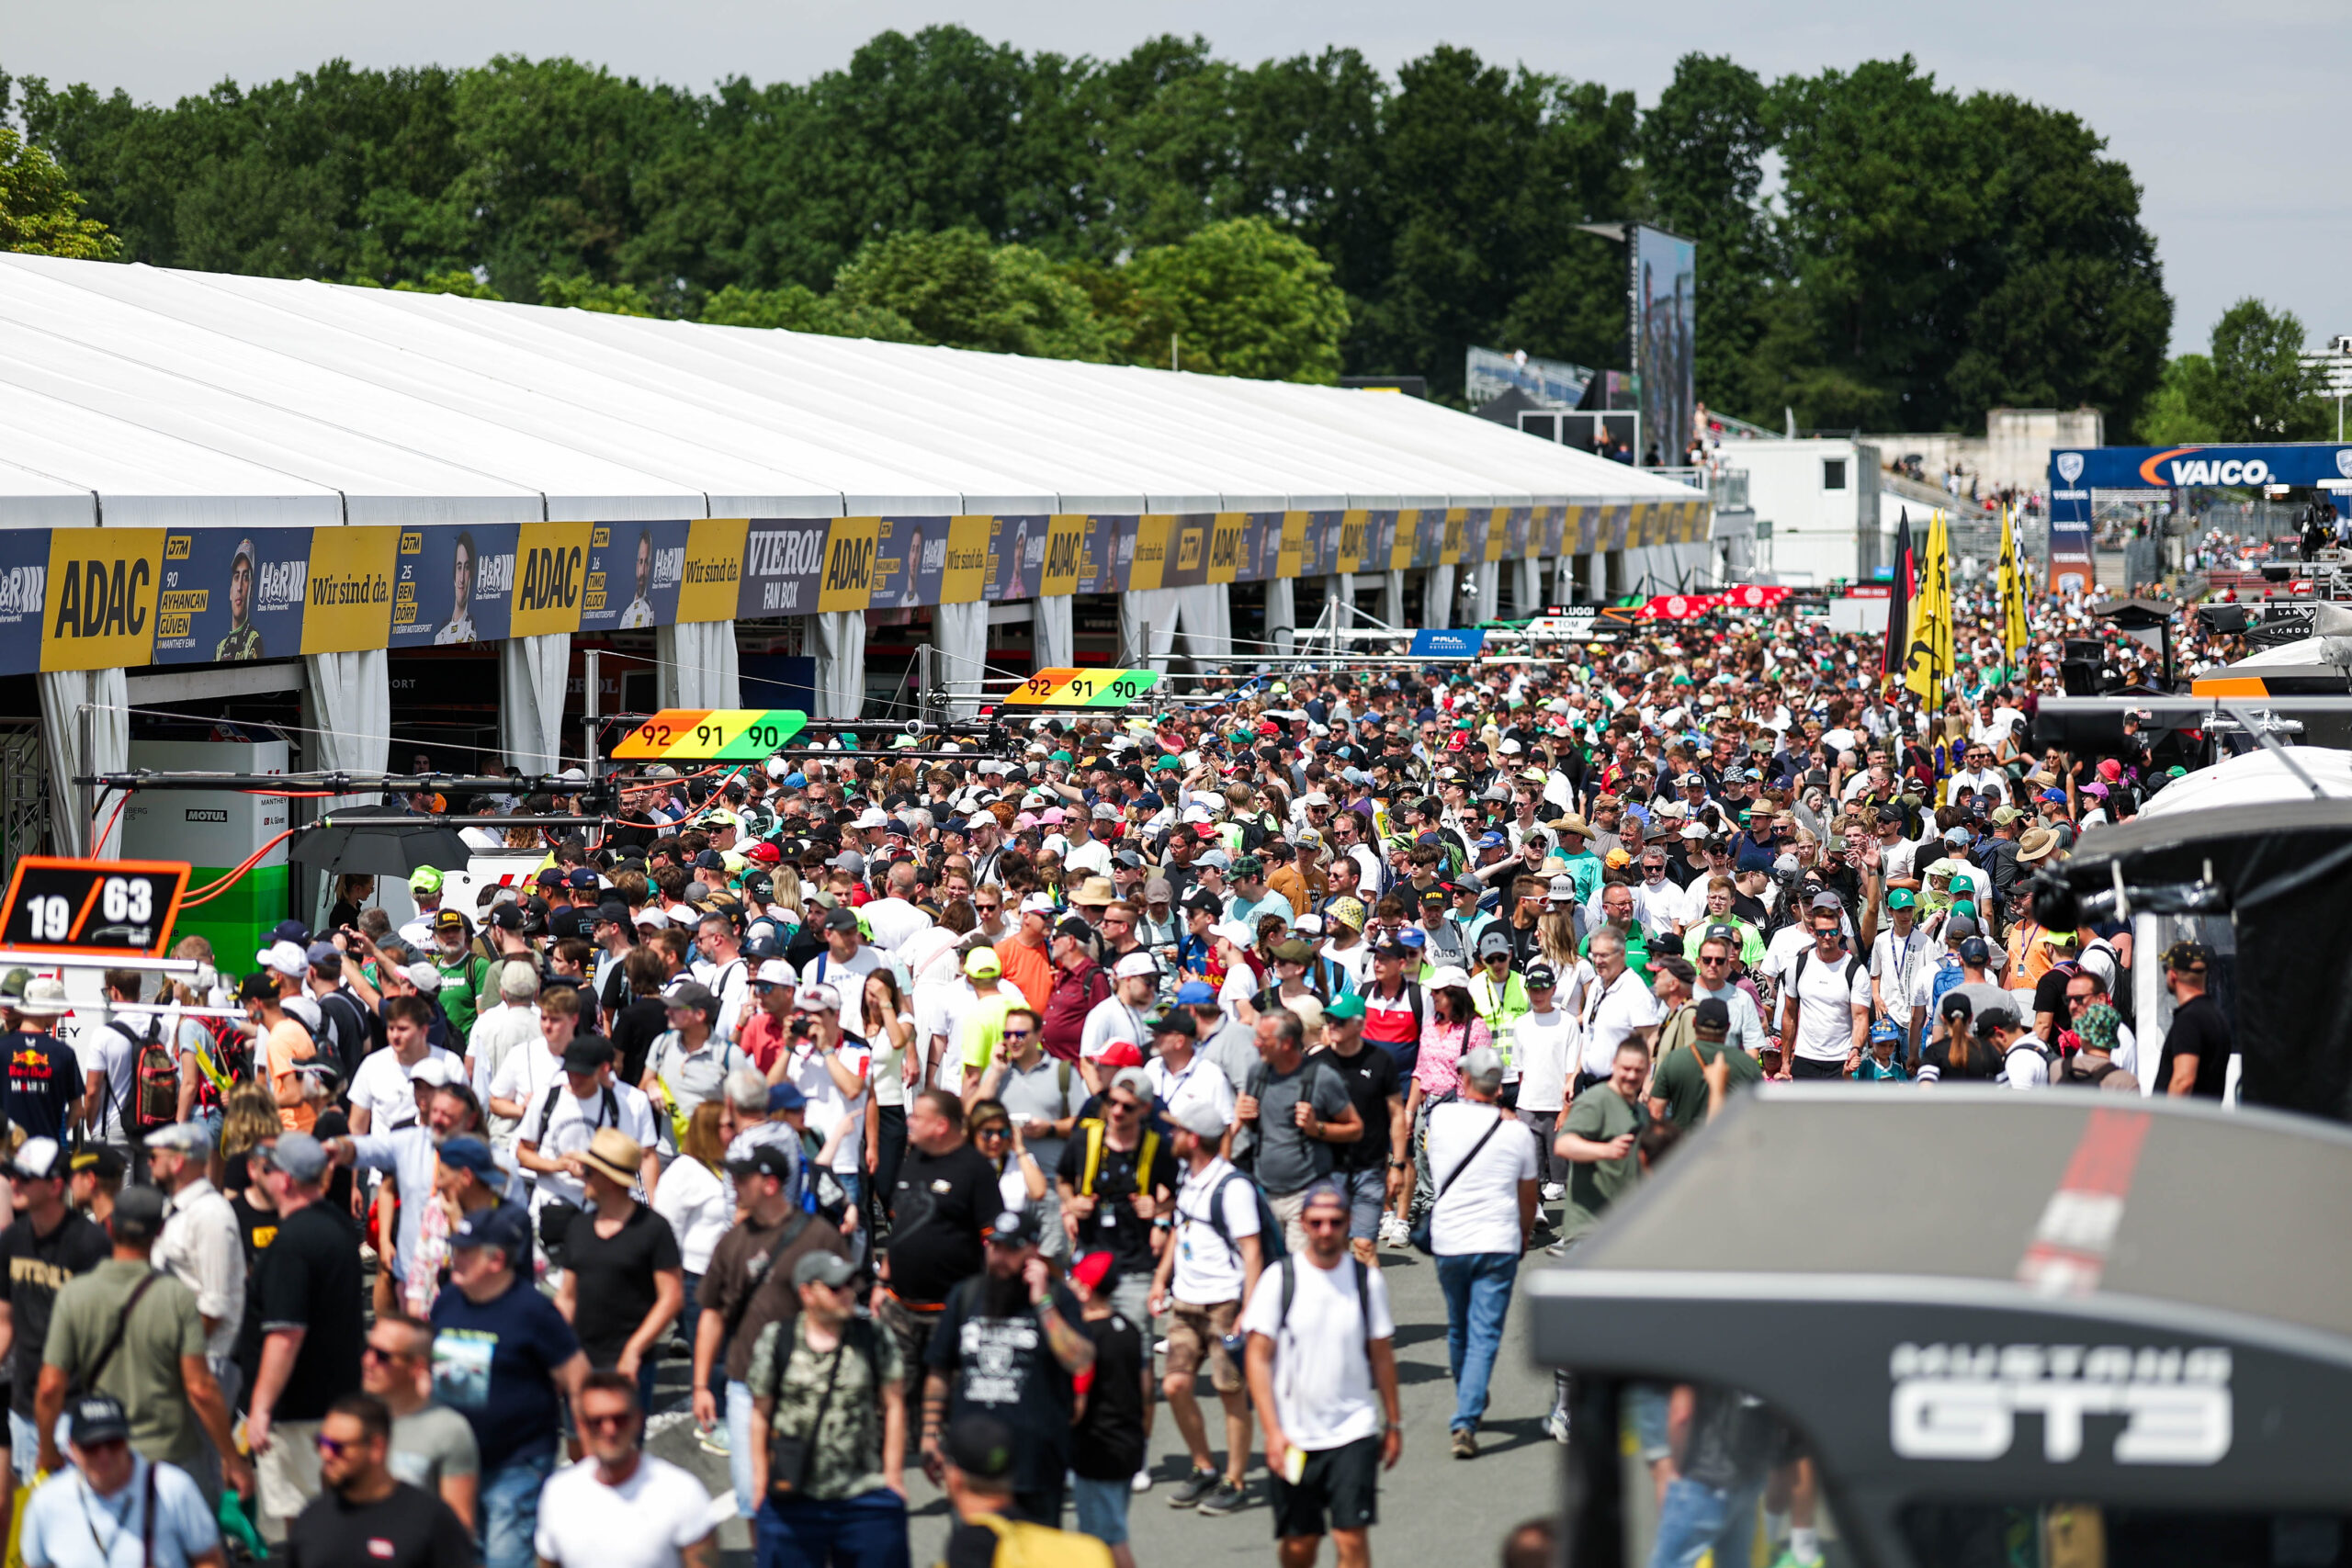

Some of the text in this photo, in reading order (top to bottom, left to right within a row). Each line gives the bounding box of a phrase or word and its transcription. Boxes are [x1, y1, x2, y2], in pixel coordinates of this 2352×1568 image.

[2171, 459, 2268, 485] VAICO
[402, 536, 420, 550] DTM
[594, 532, 608, 544] DTM
[167, 540, 189, 555] DTM
[749, 529, 823, 576] VIEROL
[1046, 532, 1080, 577] ADAC
[1180, 536, 1201, 562] DTM
[1211, 528, 1240, 568] ADAC
[401, 565, 413, 580] 25
[592, 557, 600, 570] 16
[686, 558, 704, 583] Wir
[706, 557, 726, 582] sind
[826, 537, 873, 591] ADAC
[166, 571, 178, 588] 90
[259, 561, 291, 603] H&R
[477, 555, 502, 592] H&R
[519, 546, 582, 611] ADAC
[588, 575, 605, 588] TIMO
[54, 558, 150, 638] ADAC
[312, 573, 389, 605] Wir sind da.
[398, 584, 413, 599] BEN
[763, 581, 799, 610] FAN BOX
[162, 592, 207, 610] AYHANCAN
[257, 604, 266, 612] Das
[585, 593, 605, 606] GLOCK
[395, 604, 415, 621] DÖRR
[1562, 606, 1594, 615] LUGGI
[160, 615, 189, 634] GÜVEN
[396, 624, 432, 635] DÖRR MOTORSPORT
[1028, 680, 1136, 698] 92 91 90
[642, 726, 778, 747] 92 91 90
[261, 797, 287, 806] MANTHEY
[187, 810, 226, 821] MOTUL
[103, 876, 153, 923] 63
[27, 895, 70, 942] 19
[9, 1065, 52, 1078] Red Bull
[1890, 1342, 2233, 1380] MUSTANG
